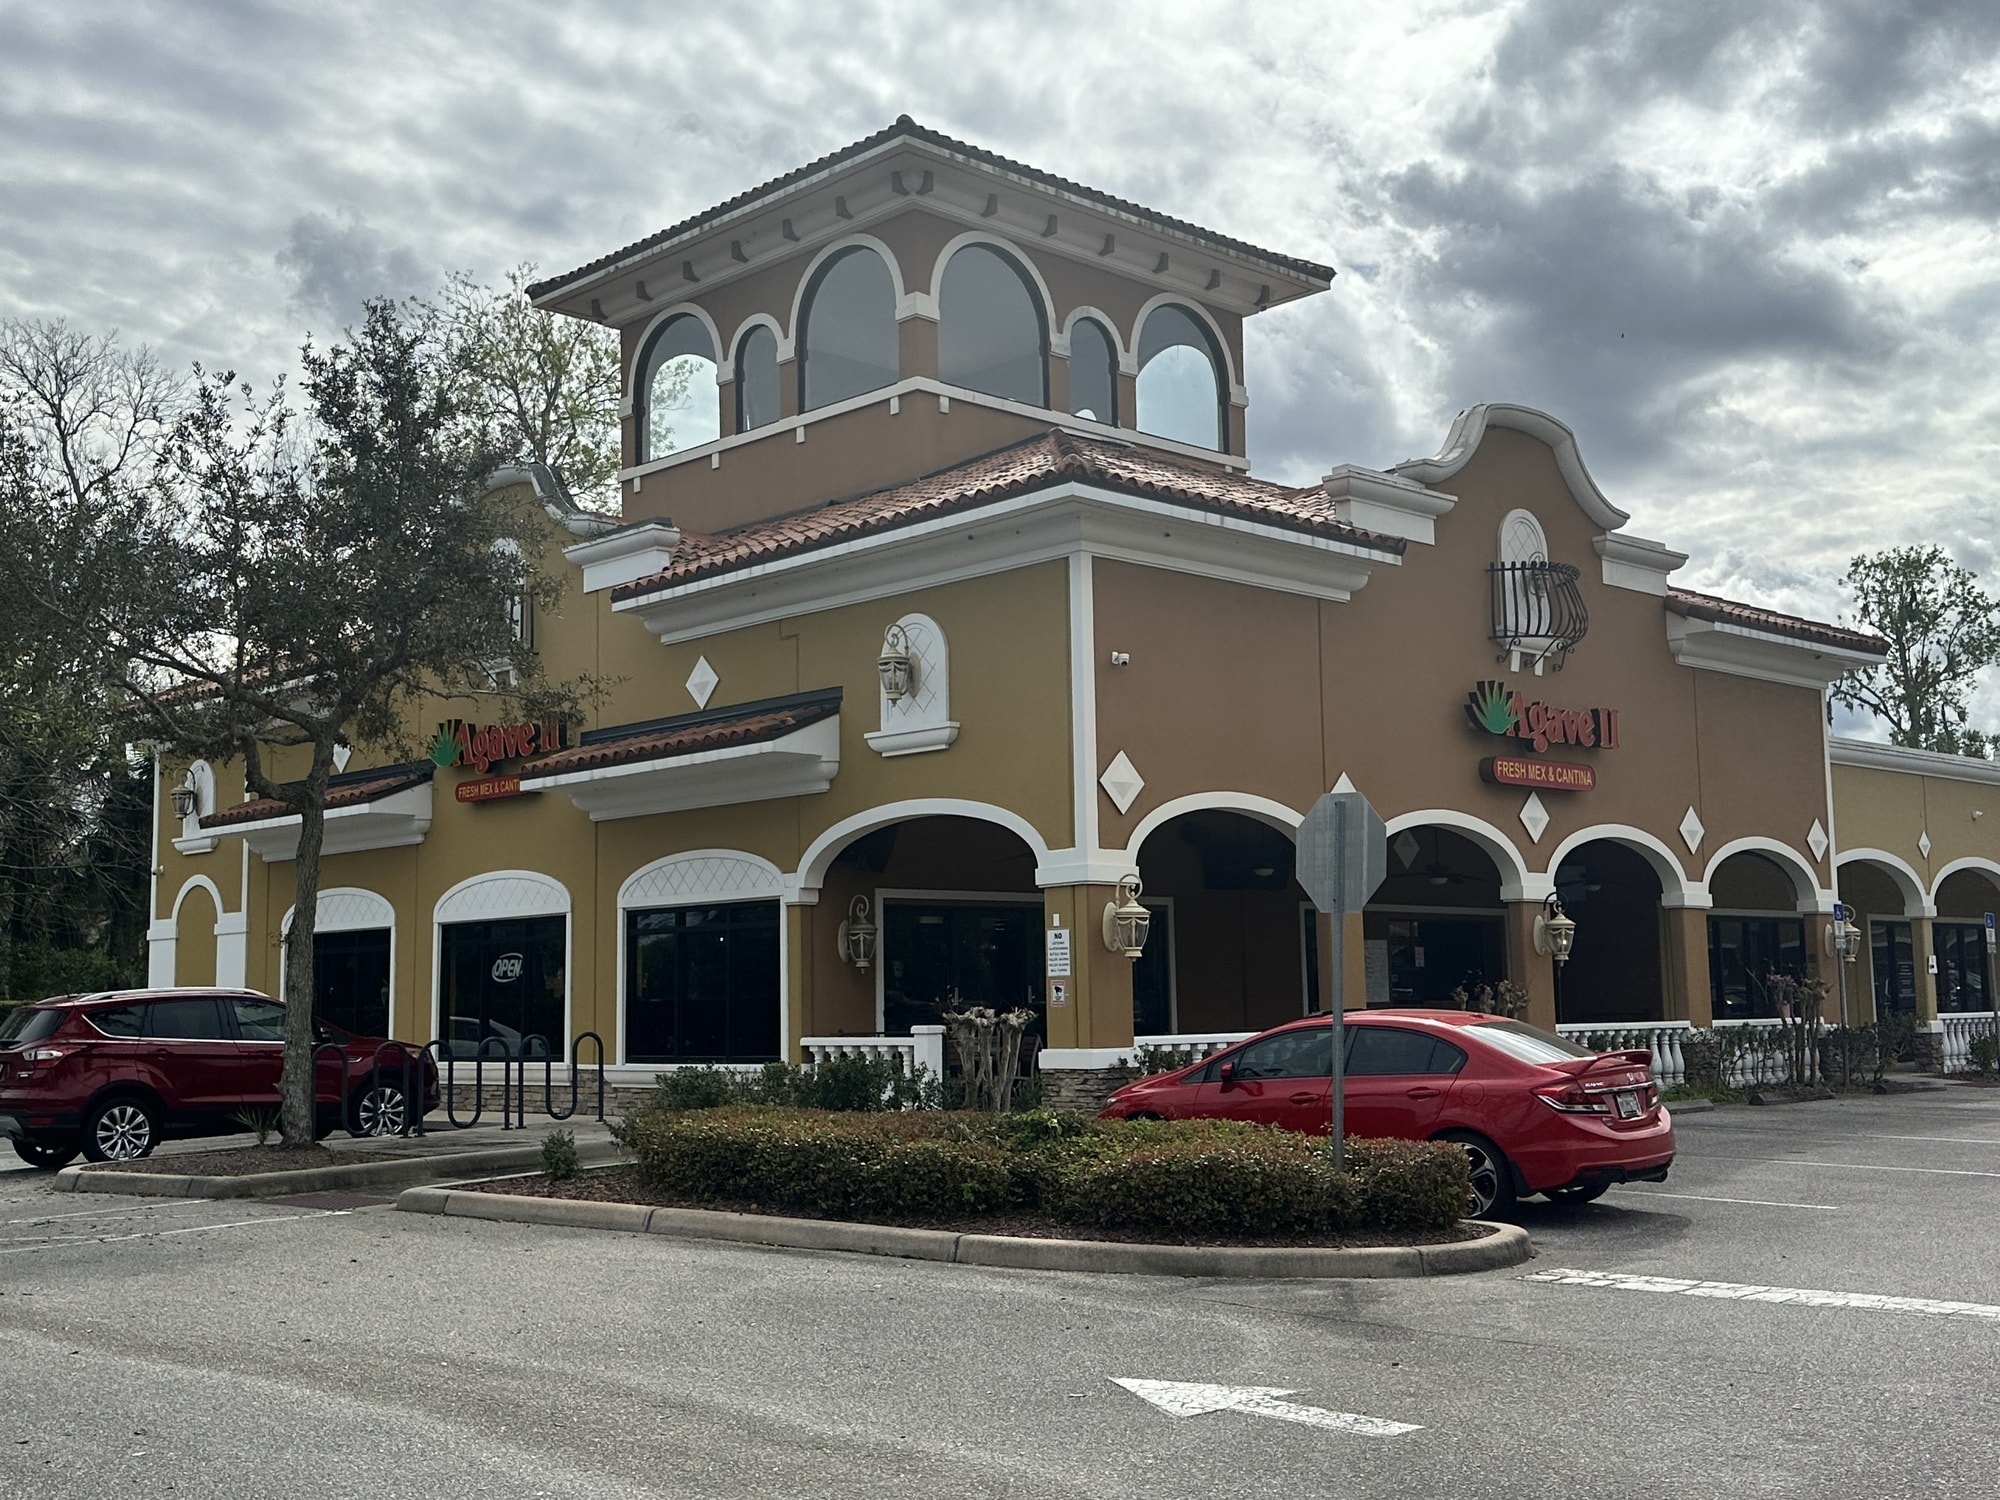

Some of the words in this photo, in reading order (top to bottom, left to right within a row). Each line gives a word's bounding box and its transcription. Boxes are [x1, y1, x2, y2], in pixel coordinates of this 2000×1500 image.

[1506, 691, 1596, 753] Agave
[453, 722, 535, 774] Agave
[1497, 761, 1527, 779] FRESH
[1528, 764, 1546, 782] MEX
[1549, 766, 1555, 781] &
[1556, 767, 1593, 786] CANTINA
[458, 784, 479, 799] FRESH
[480, 782, 494, 795] MEX
[494, 781, 499, 794] &
[500, 778, 520, 793] CANT
[494, 959, 522, 977] OPEN
